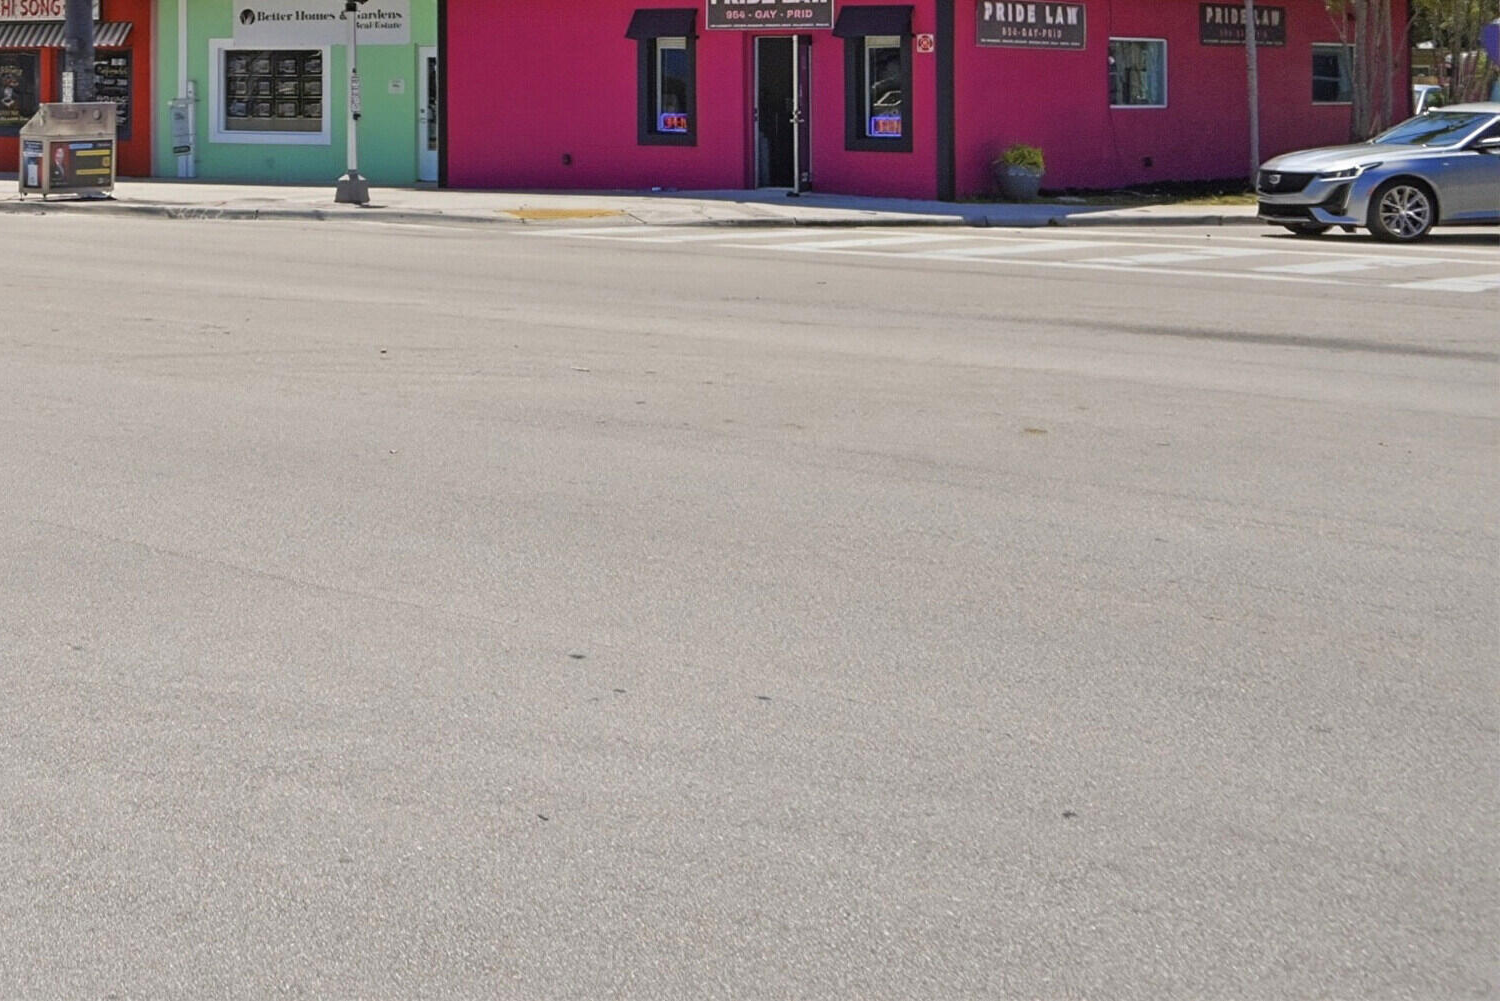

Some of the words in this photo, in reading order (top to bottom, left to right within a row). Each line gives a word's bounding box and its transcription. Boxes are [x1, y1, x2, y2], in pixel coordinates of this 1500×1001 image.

[257, 11, 292, 22] Better
[295, 10, 336, 21] Homes
[786, 9, 813, 19] PRID
[983, 1, 1036, 24] PRIDE
[1045, 5, 1079, 25] LAW
